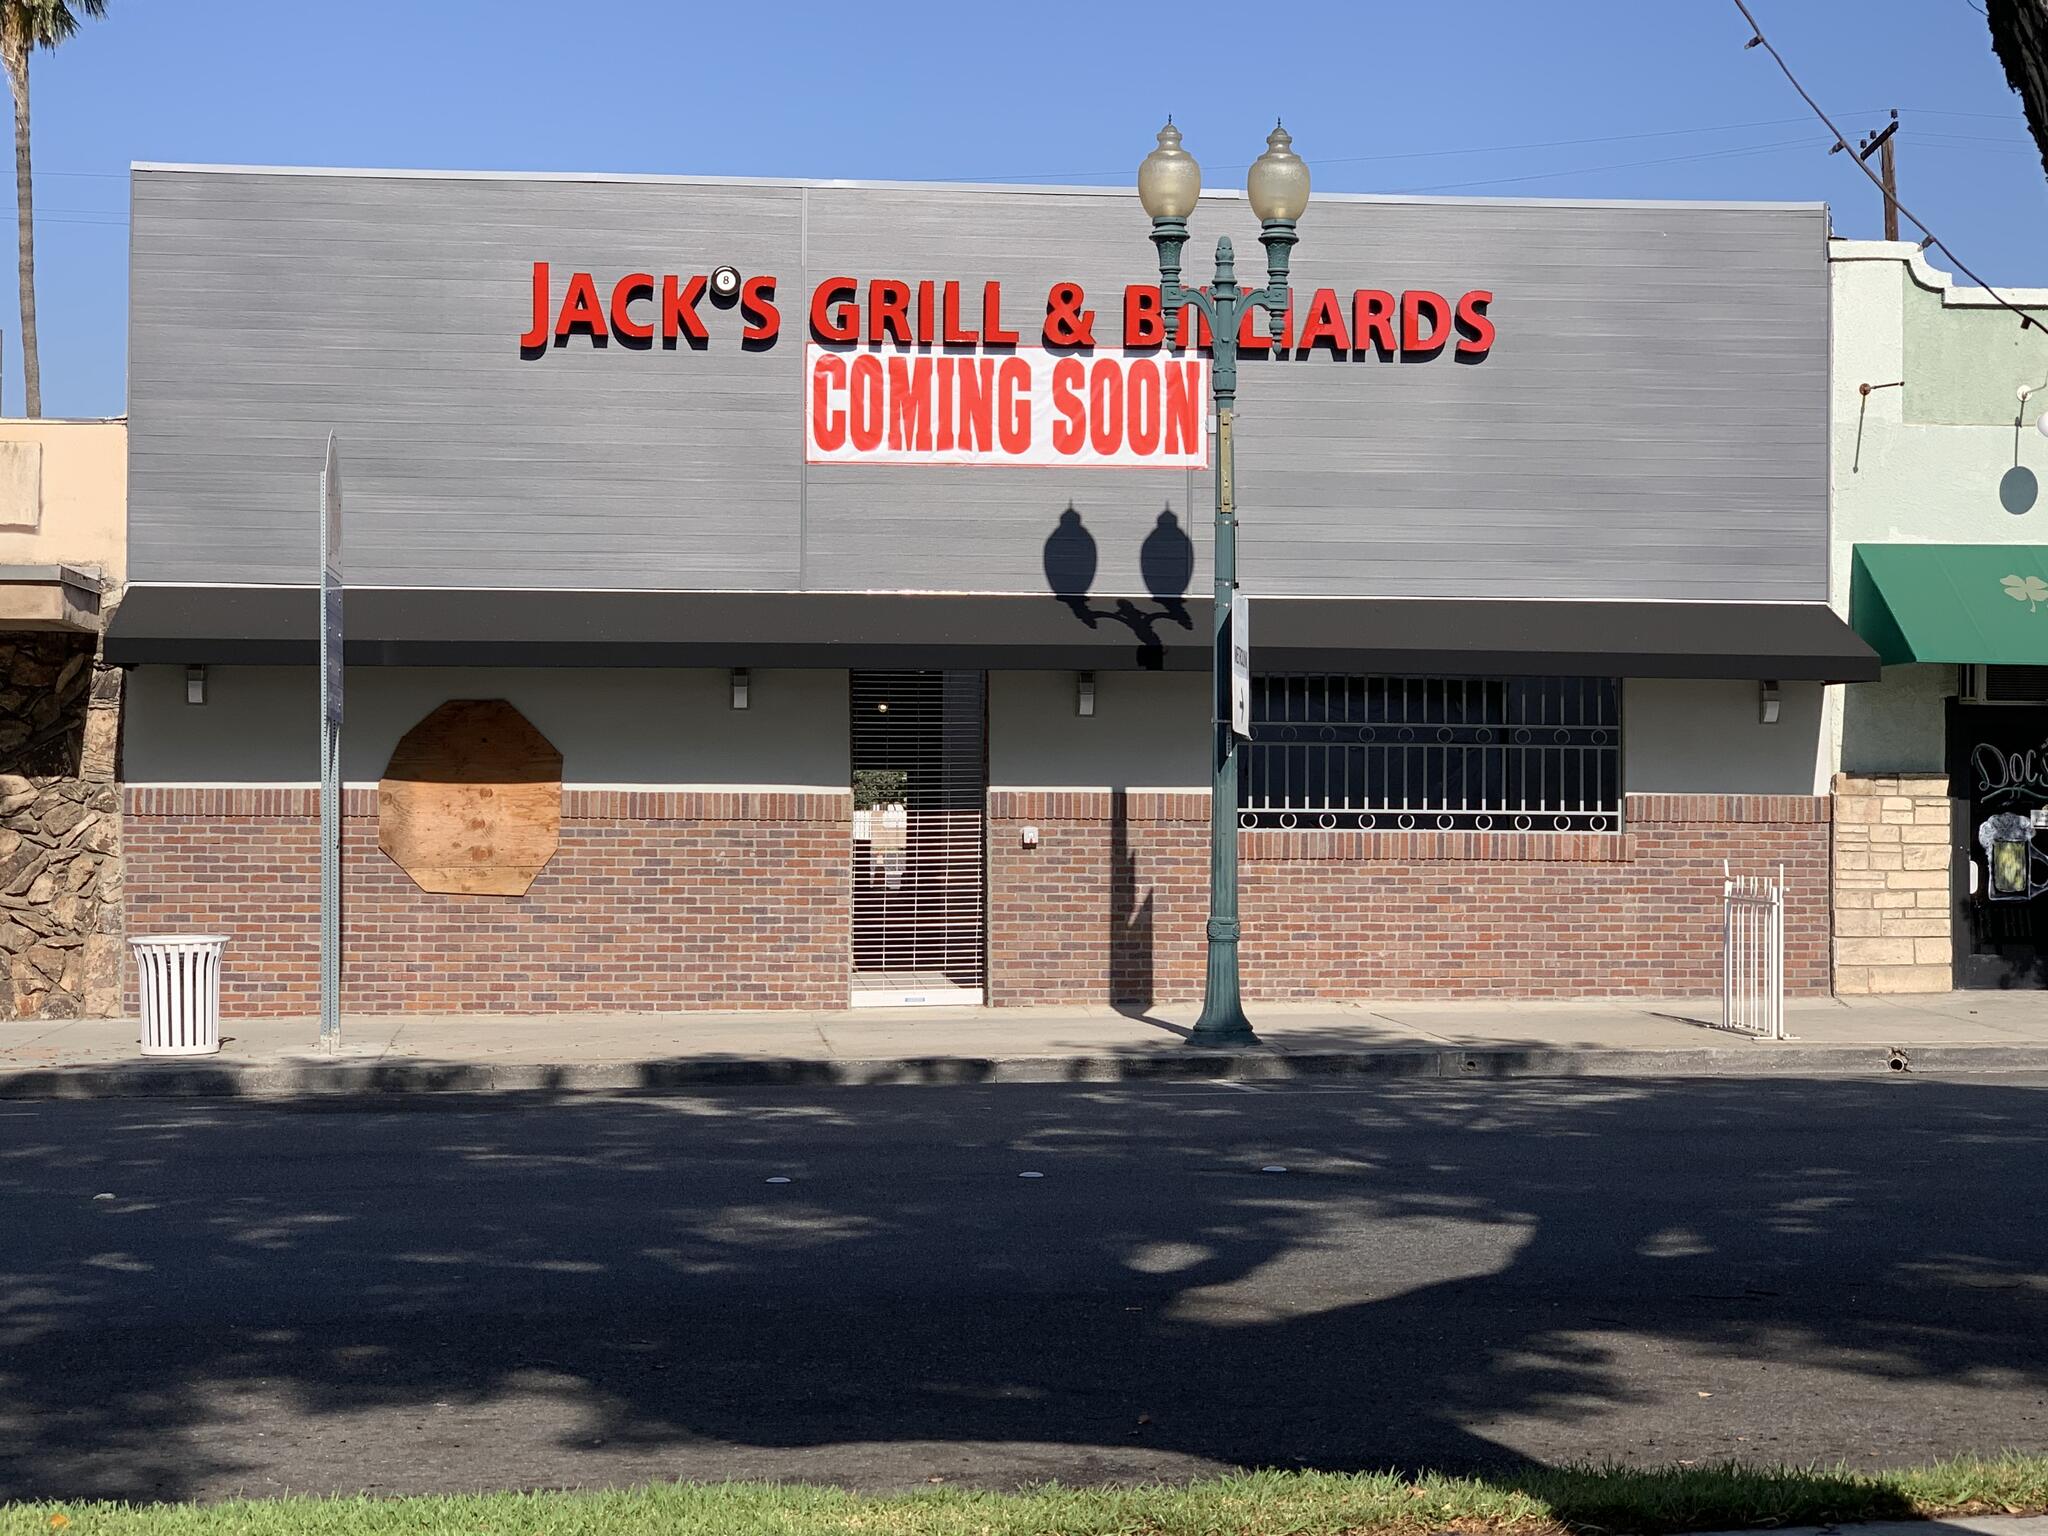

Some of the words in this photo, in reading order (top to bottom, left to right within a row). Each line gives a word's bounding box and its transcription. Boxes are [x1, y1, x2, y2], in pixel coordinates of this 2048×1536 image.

[521, 262, 782, 348] JACK'S
[811, 277, 1020, 344] GRILL
[1043, 282, 1096, 346] &
[814, 354, 1032, 455] COMING
[1053, 358, 1200, 456] SOON
